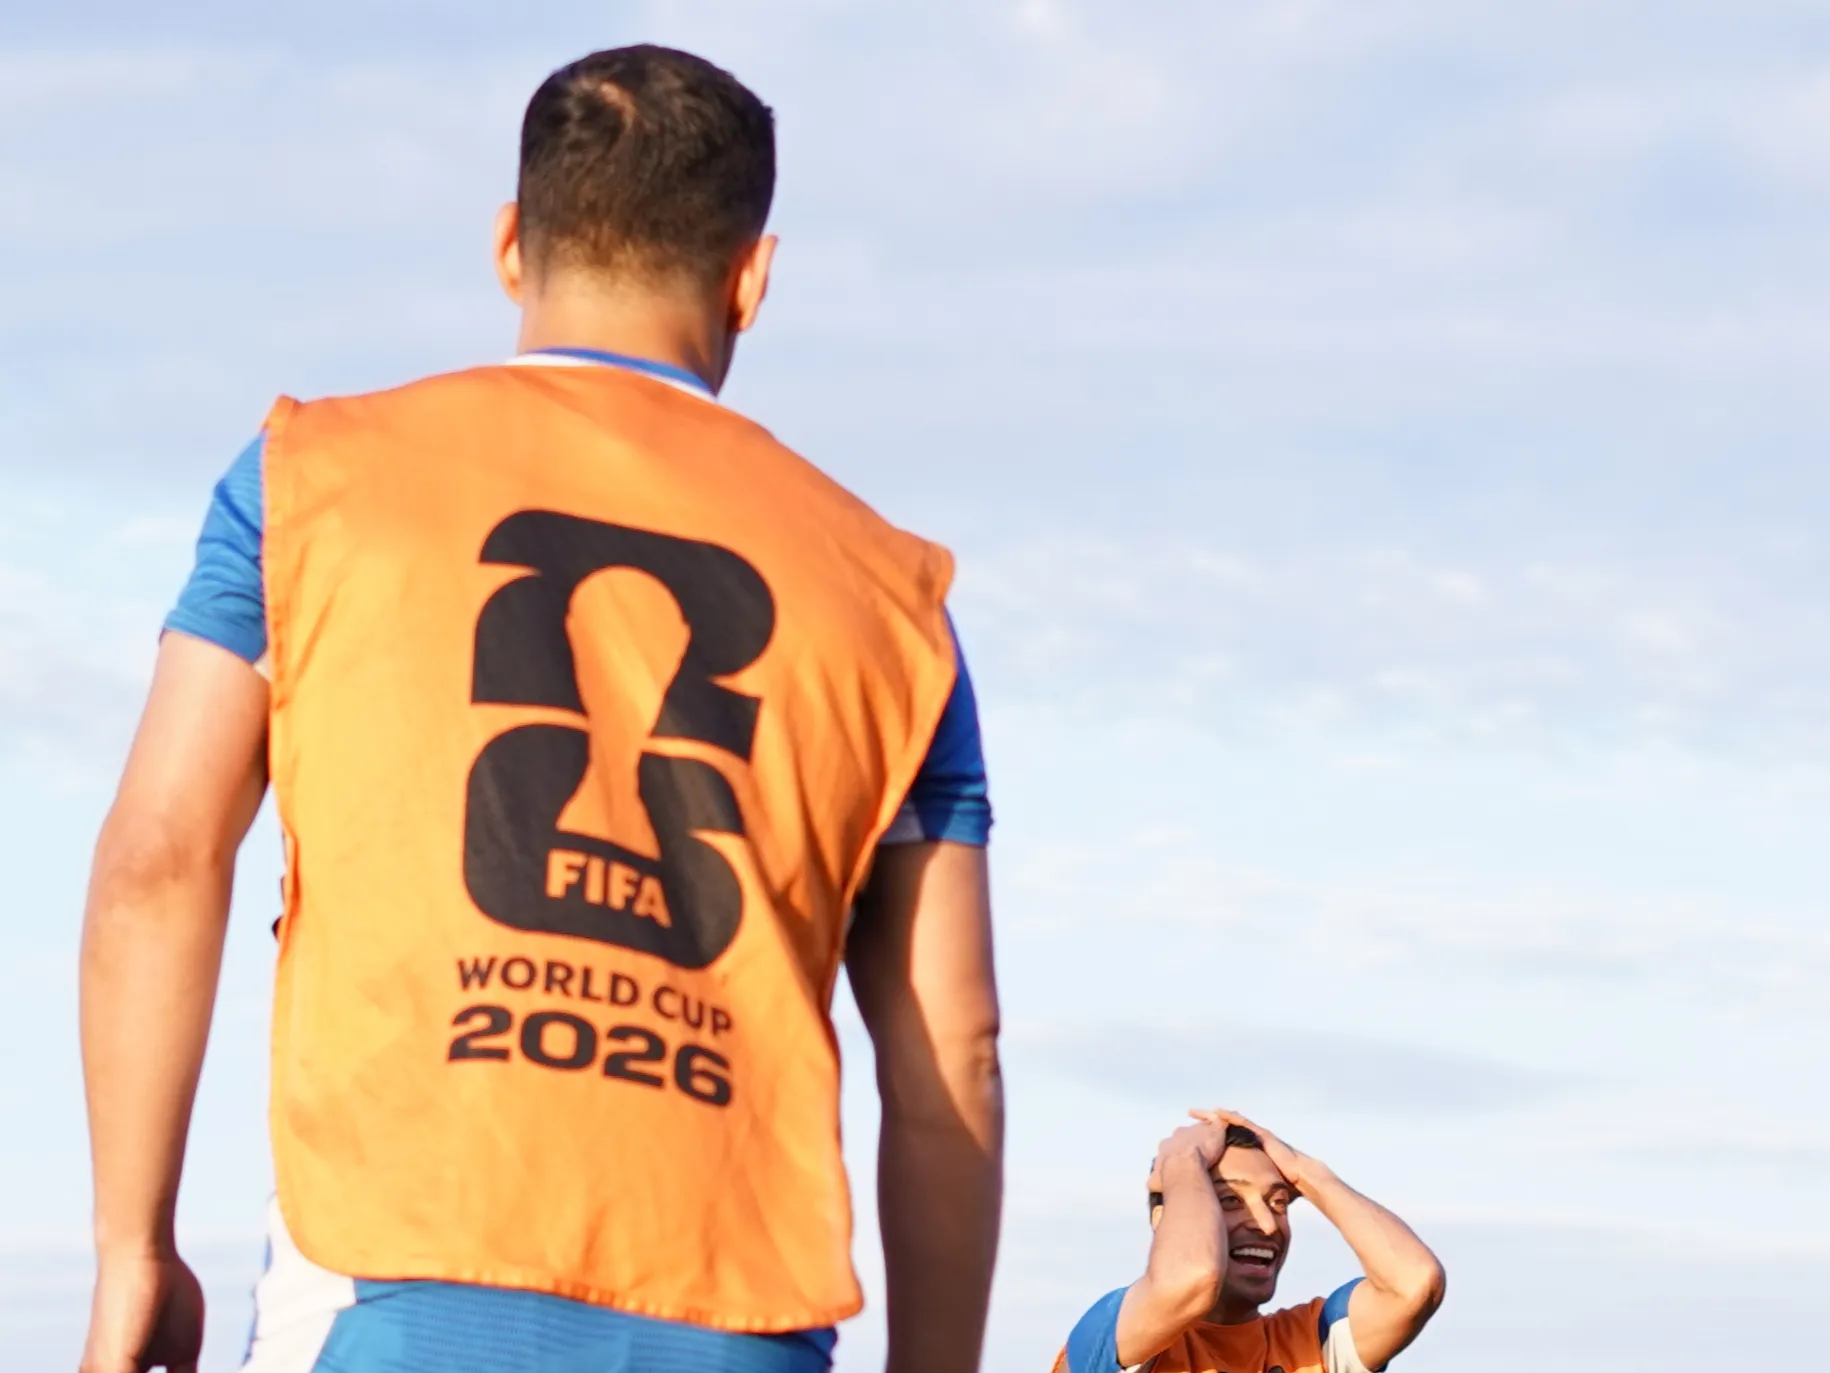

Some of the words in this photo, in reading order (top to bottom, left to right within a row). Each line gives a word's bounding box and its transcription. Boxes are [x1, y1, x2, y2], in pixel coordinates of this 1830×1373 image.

[544, 847, 672, 929] FIFA
[456, 954, 640, 1008] WORLD
[652, 984, 734, 1037] CUP
[447, 1003, 735, 1109] 2026
